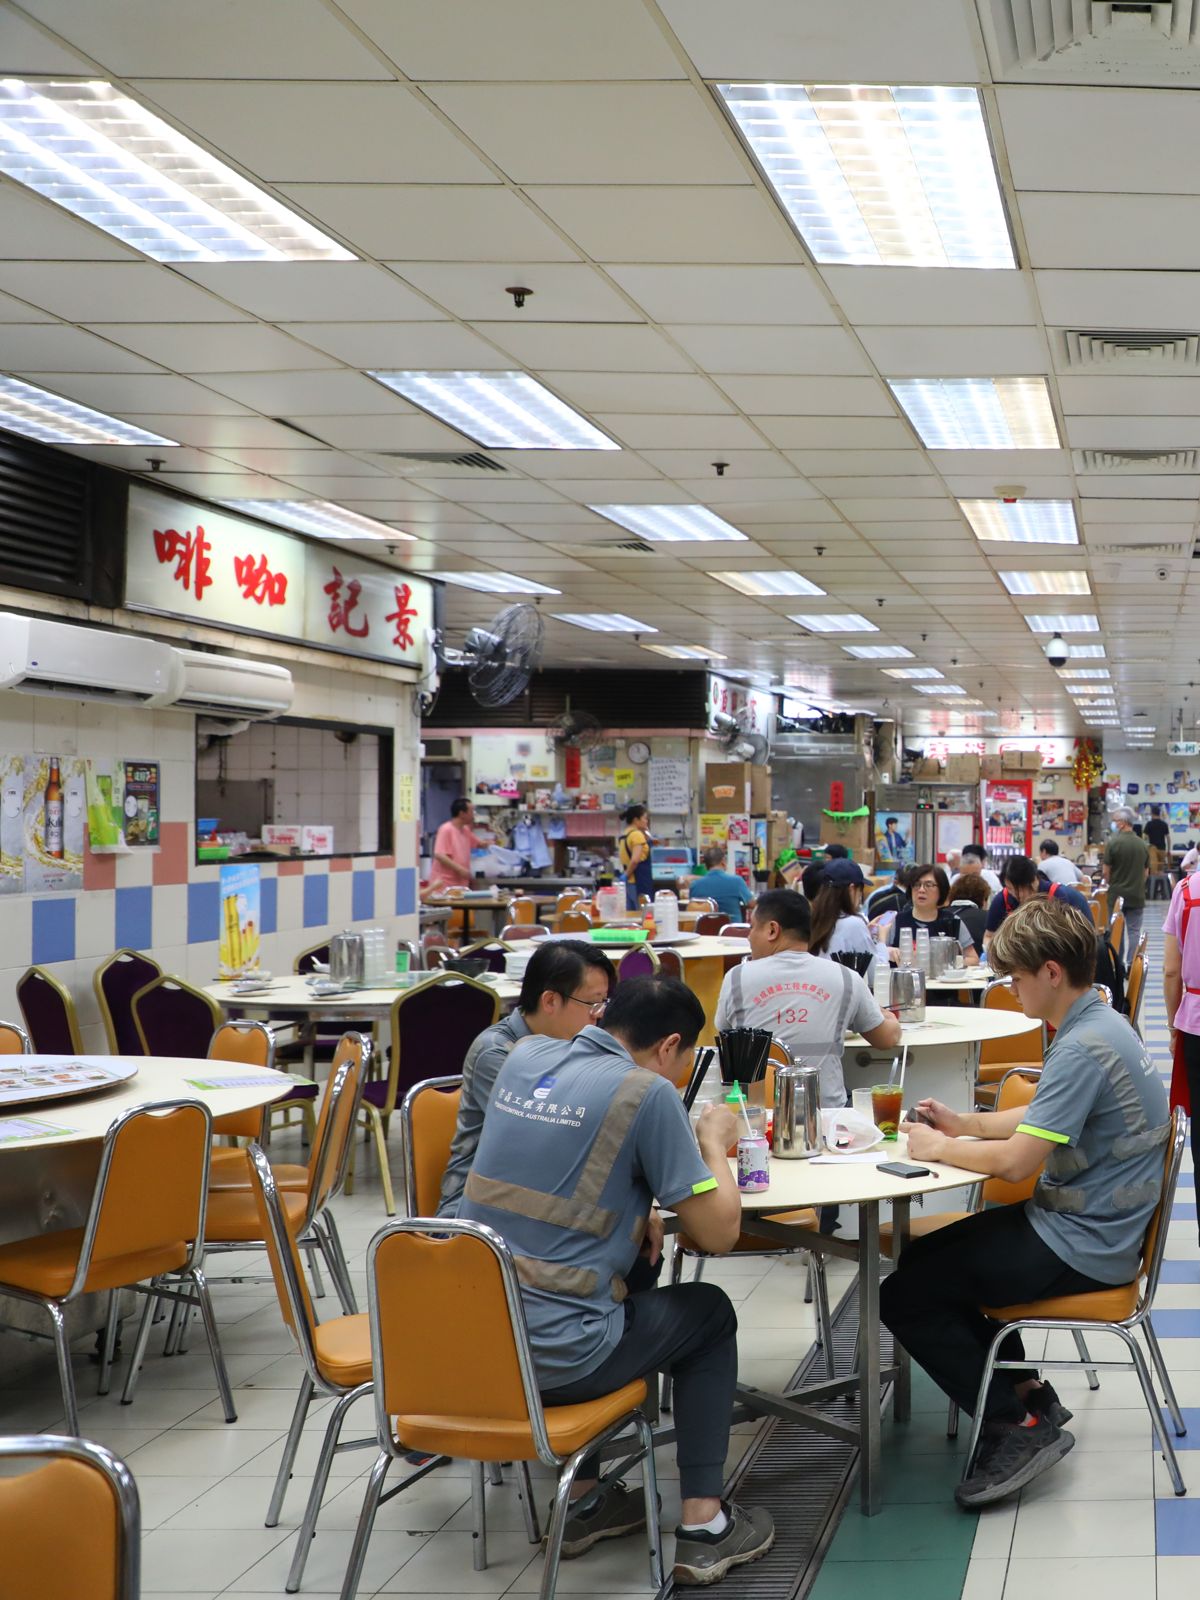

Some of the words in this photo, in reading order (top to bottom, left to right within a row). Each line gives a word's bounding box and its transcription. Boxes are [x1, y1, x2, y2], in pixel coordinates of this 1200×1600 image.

[775, 1008, 808, 1025] 132
[524, 1112, 555, 1124] AUSTRALIA
[555, 1116, 582, 1128] LIMITED
